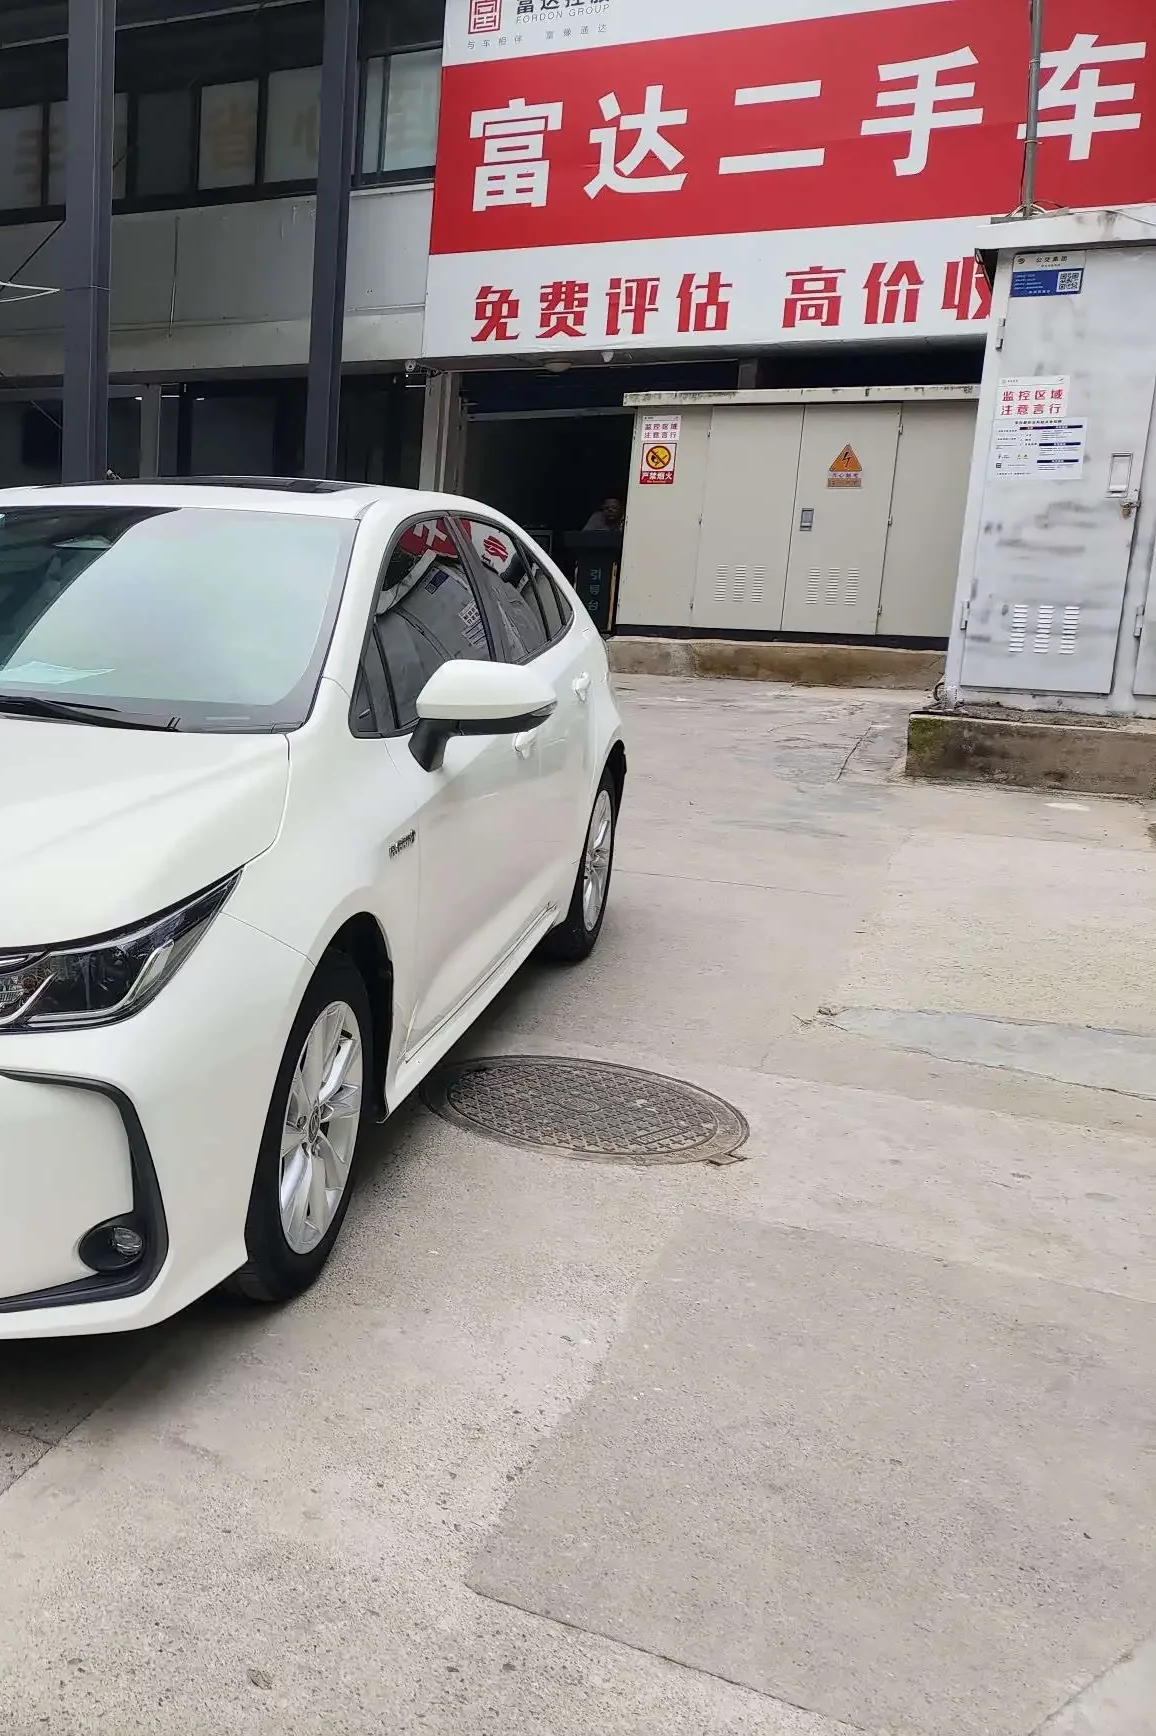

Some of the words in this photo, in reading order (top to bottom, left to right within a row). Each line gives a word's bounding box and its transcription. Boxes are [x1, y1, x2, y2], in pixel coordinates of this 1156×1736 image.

[516, 12, 563, 24] FORDON
[569, 3, 610, 17] GROUP
[467, 34, 523, 50] 与车相伴
[468, 33, 1147, 212] 富达二手车
[471, 271, 733, 342] 免费评估
[1001, 388, 1064, 402] 监控区域
[1000, 402, 1062, 416] 注意言行
[641, 471, 673, 480] 严禁烟火
